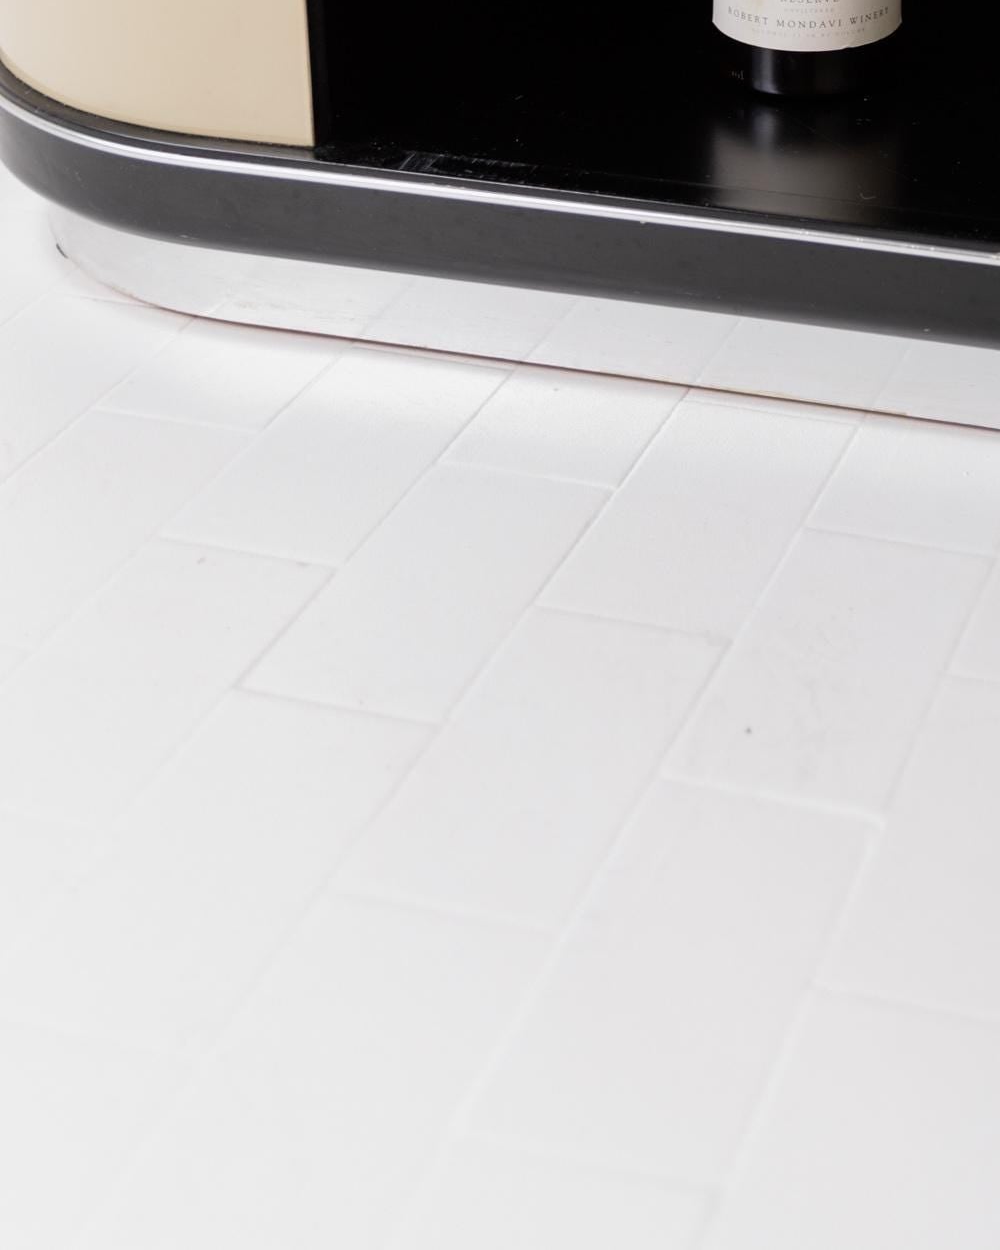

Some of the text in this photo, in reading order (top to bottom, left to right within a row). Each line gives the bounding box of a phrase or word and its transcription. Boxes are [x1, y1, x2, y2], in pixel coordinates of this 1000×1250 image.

[728, 6, 889, 29] ROBERT MONDAVI WINERY
